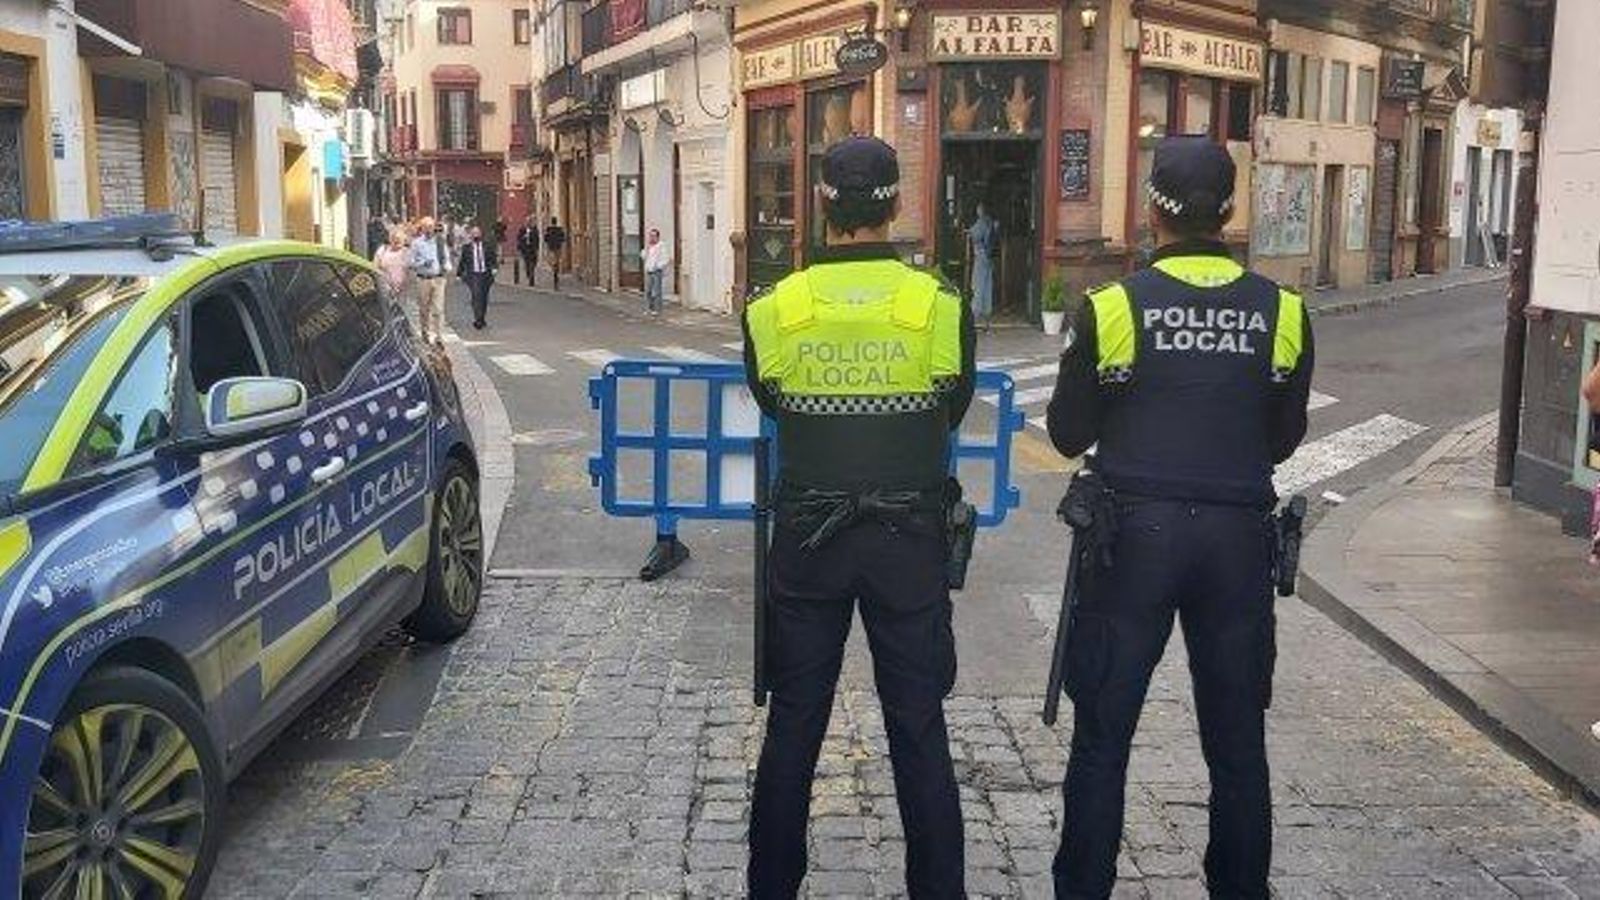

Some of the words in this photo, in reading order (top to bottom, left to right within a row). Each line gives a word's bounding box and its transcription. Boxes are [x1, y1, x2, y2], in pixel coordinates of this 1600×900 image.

[967, 16, 1022, 33] BAR
[937, 36, 1053, 53] ALFALFA
[1141, 28, 1173, 58] BAR
[1203, 40, 1260, 73] ALFALFA
[1143, 306, 1267, 332] POLICIA
[798, 340, 908, 363] POLICIA
[1155, 330, 1255, 354] LOCAL
[805, 365, 901, 387] LOCAL
[233, 502, 343, 600] POLICÍA
[351, 460, 416, 523] LOCAL
